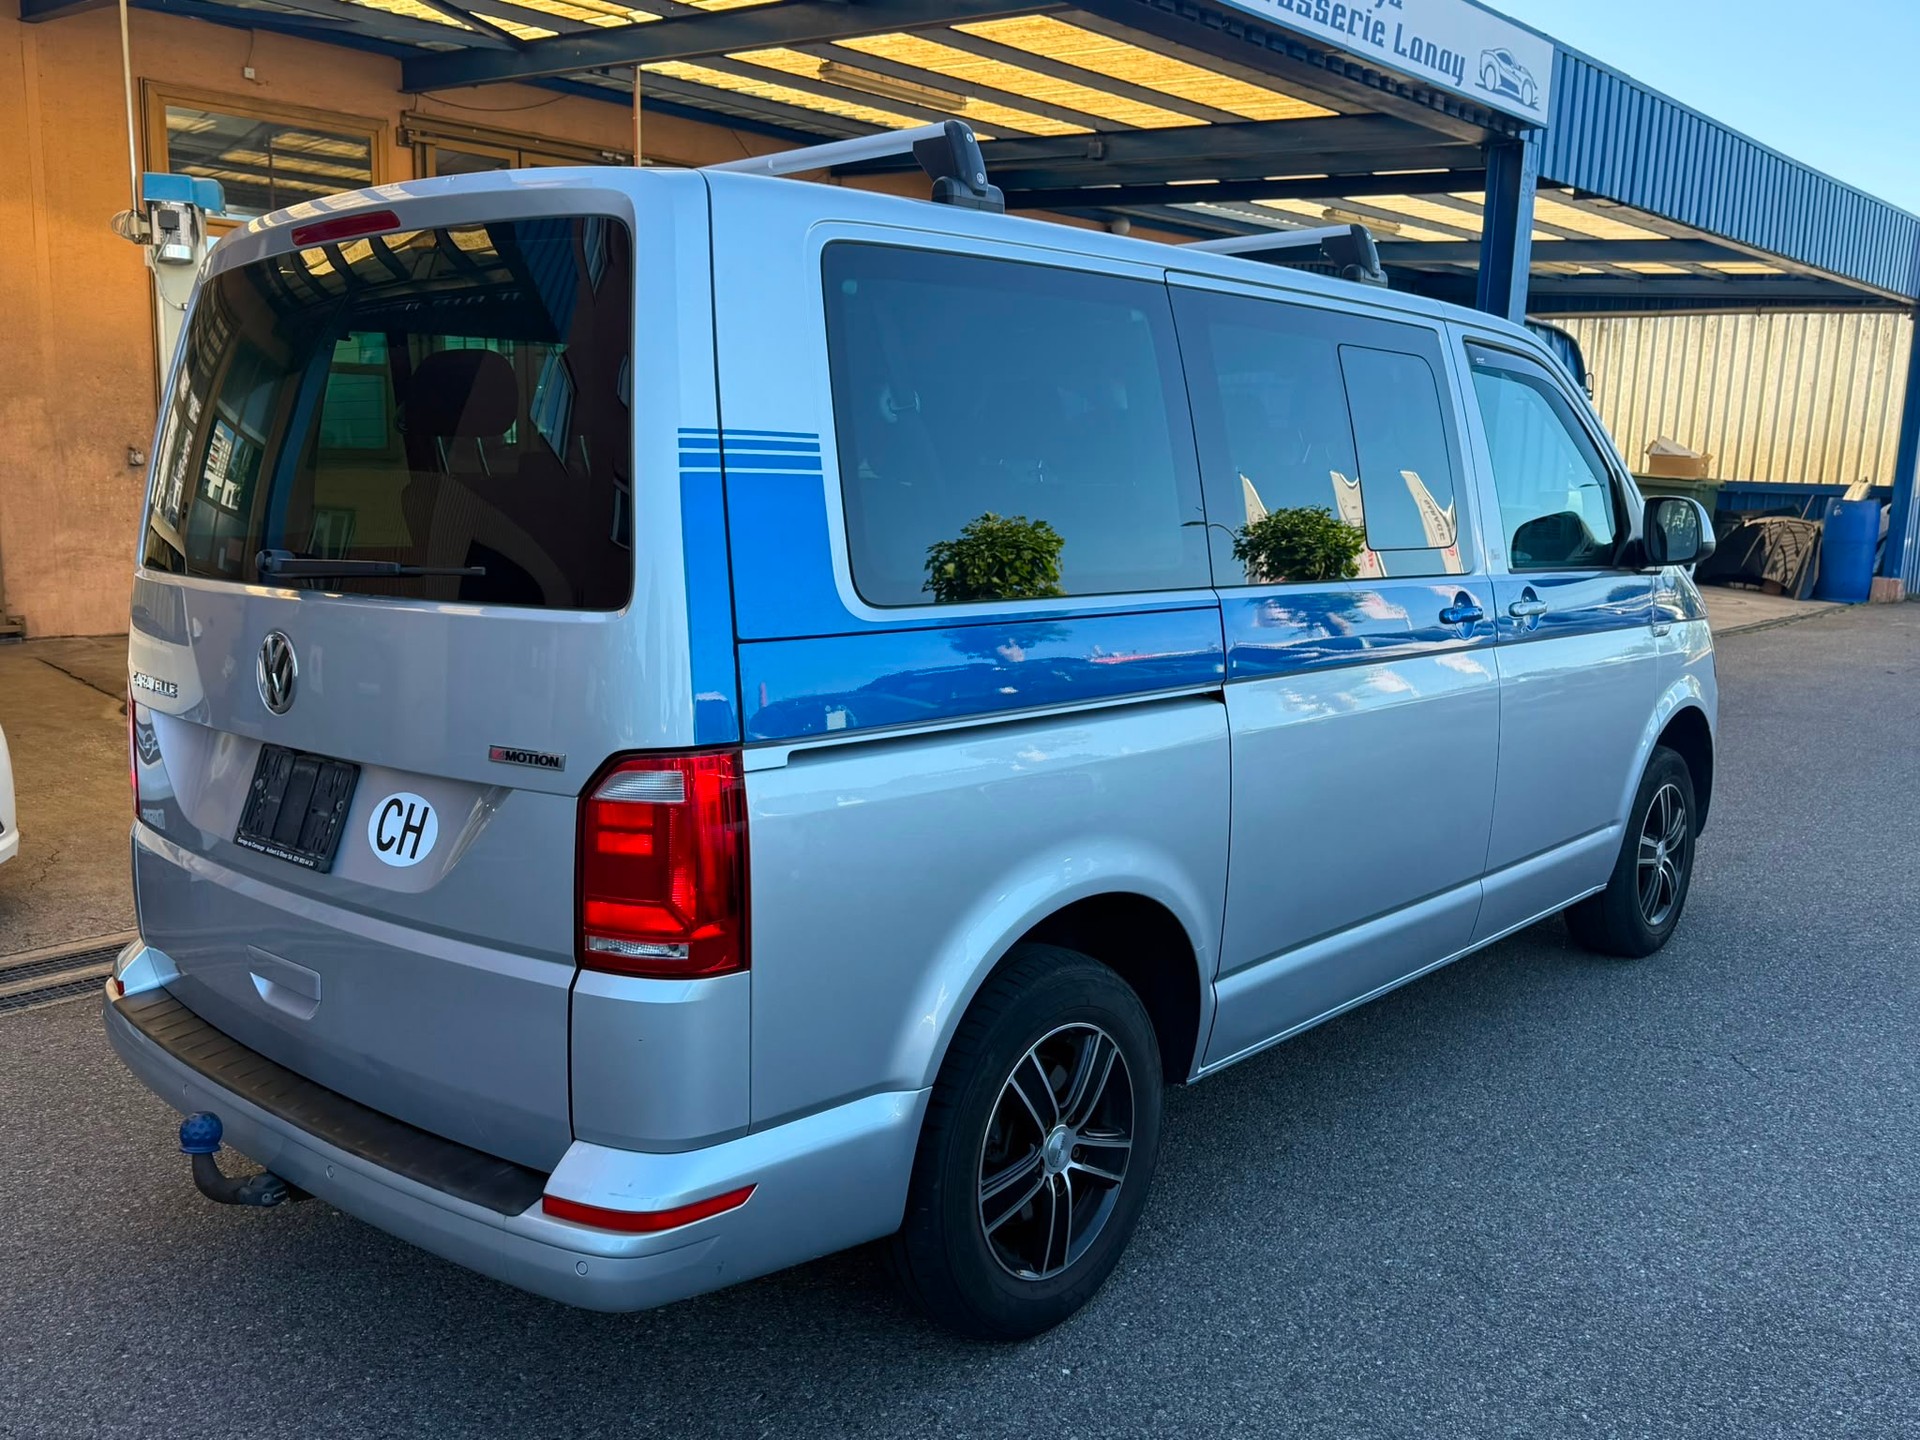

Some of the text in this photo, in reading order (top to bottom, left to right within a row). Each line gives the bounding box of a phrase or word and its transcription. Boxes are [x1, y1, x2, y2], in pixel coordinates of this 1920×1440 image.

[1266, 0, 1466, 87] sserie Lonay
[376, 798, 430, 860] CH
